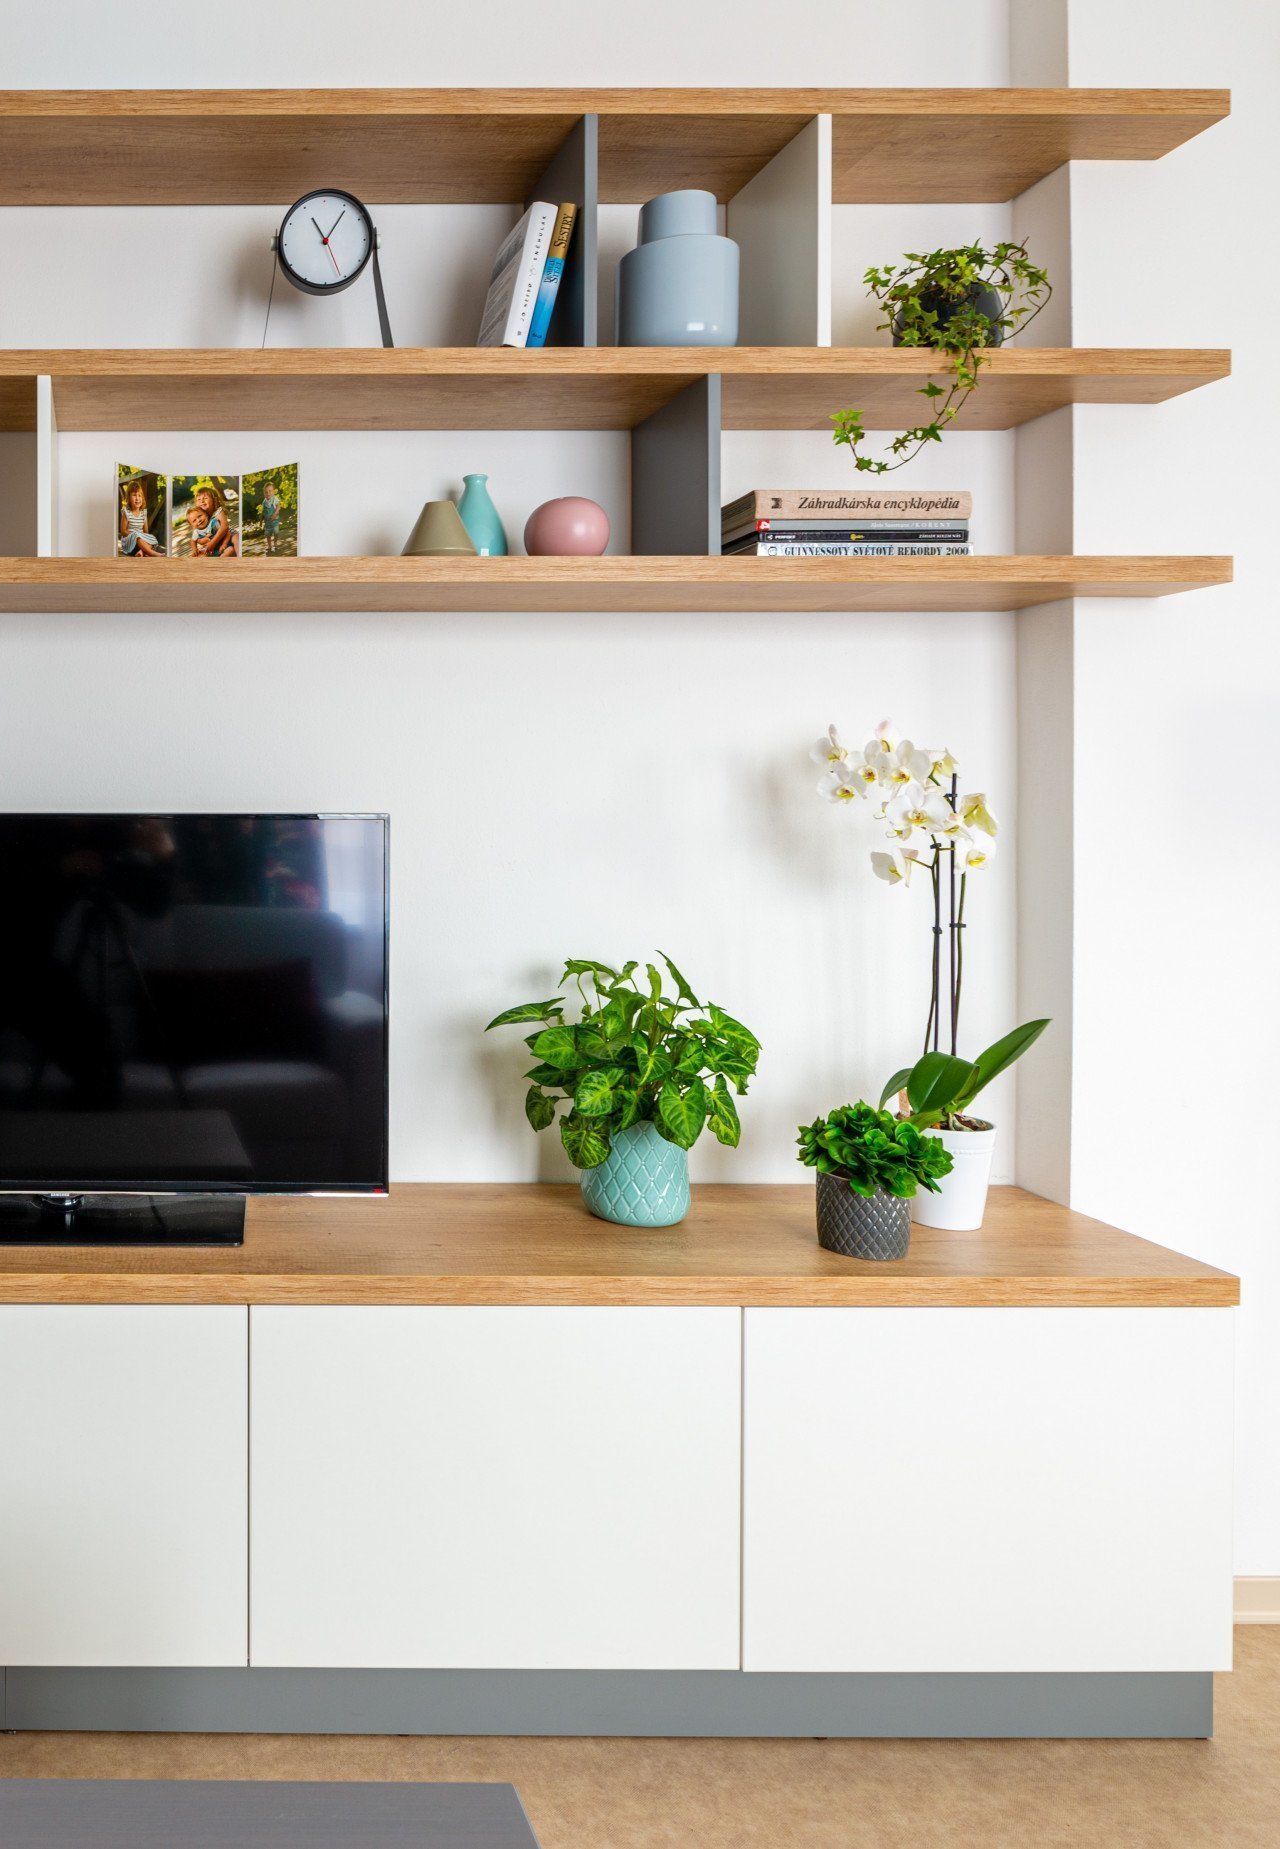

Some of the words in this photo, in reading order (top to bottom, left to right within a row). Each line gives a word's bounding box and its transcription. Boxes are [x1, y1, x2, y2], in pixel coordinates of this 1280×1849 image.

[554, 213, 573, 248] SESTRY
[798, 497, 880, 510] Záhradkárska
[884, 497, 960, 512] encyklopédia
[784, 546, 850, 556] GUINNESSOVY
[852, 544, 892, 556] SVĚTOVÉ
[897, 546, 943, 556] REKORDY
[946, 546, 969, 556] 2000
